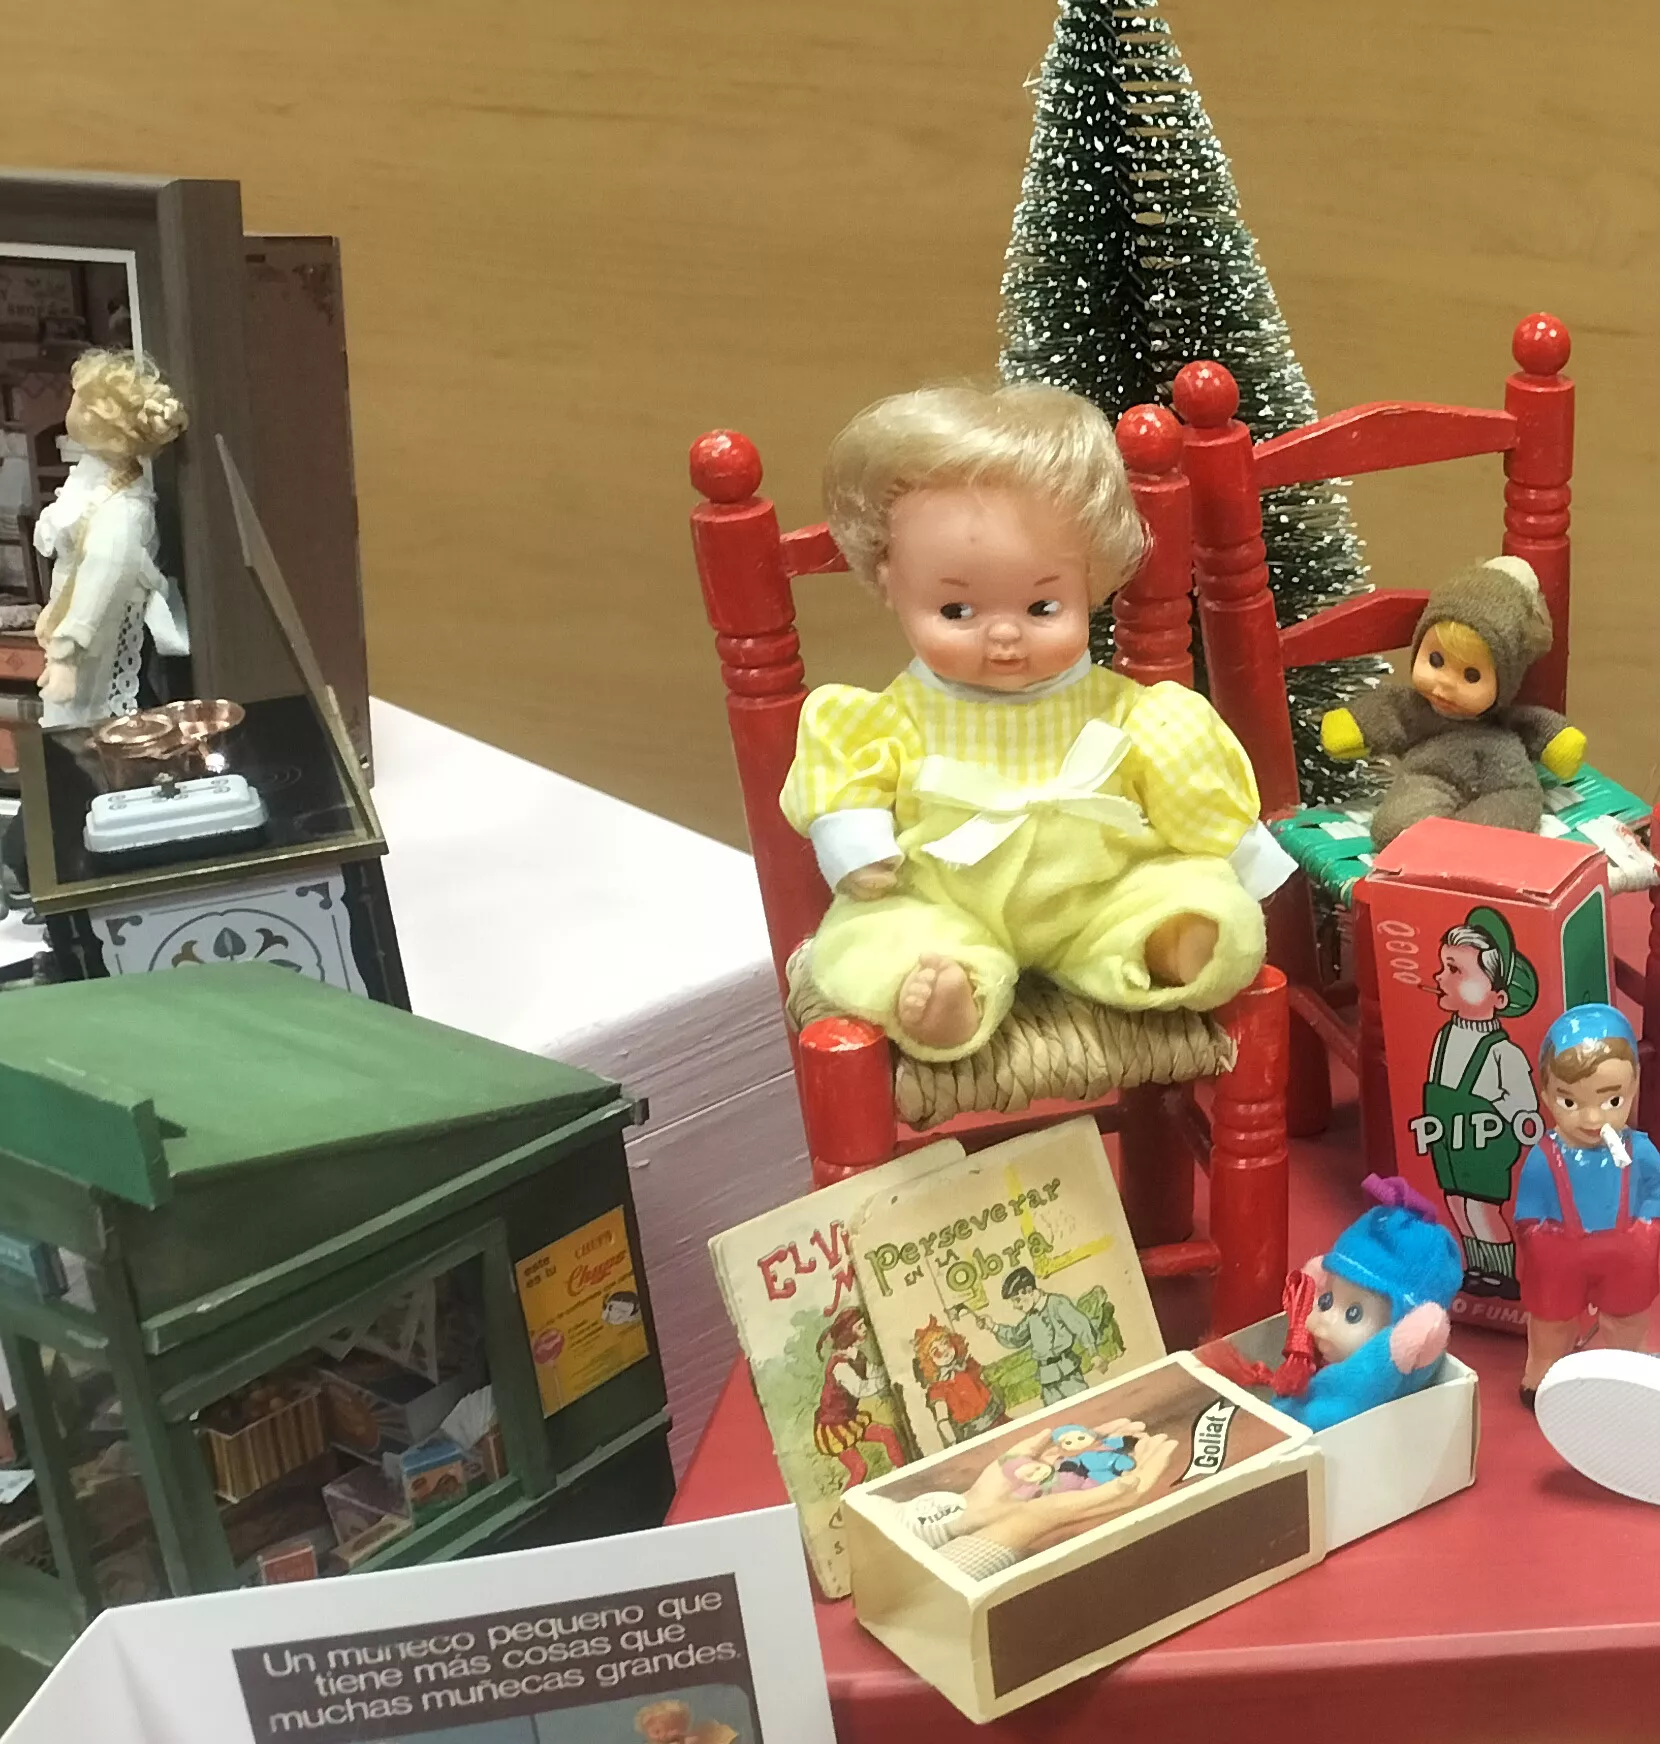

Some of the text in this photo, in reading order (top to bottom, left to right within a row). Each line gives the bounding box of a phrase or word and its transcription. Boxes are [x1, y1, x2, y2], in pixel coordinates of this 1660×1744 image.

[1409, 1110, 1545, 1156] PIPO
[864, 1178, 1061, 1297] Perseverar
[904, 1248, 960, 1287] EN LA
[946, 1231, 1054, 1298] Obra
[1194, 1416, 1227, 1468] Goliat
[263, 1649, 317, 1677] Un
[658, 1591, 722, 1620] que
[314, 1623, 686, 1698] tiene más cosas que
[269, 1641, 742, 1733] muchas muñecas grandes.
